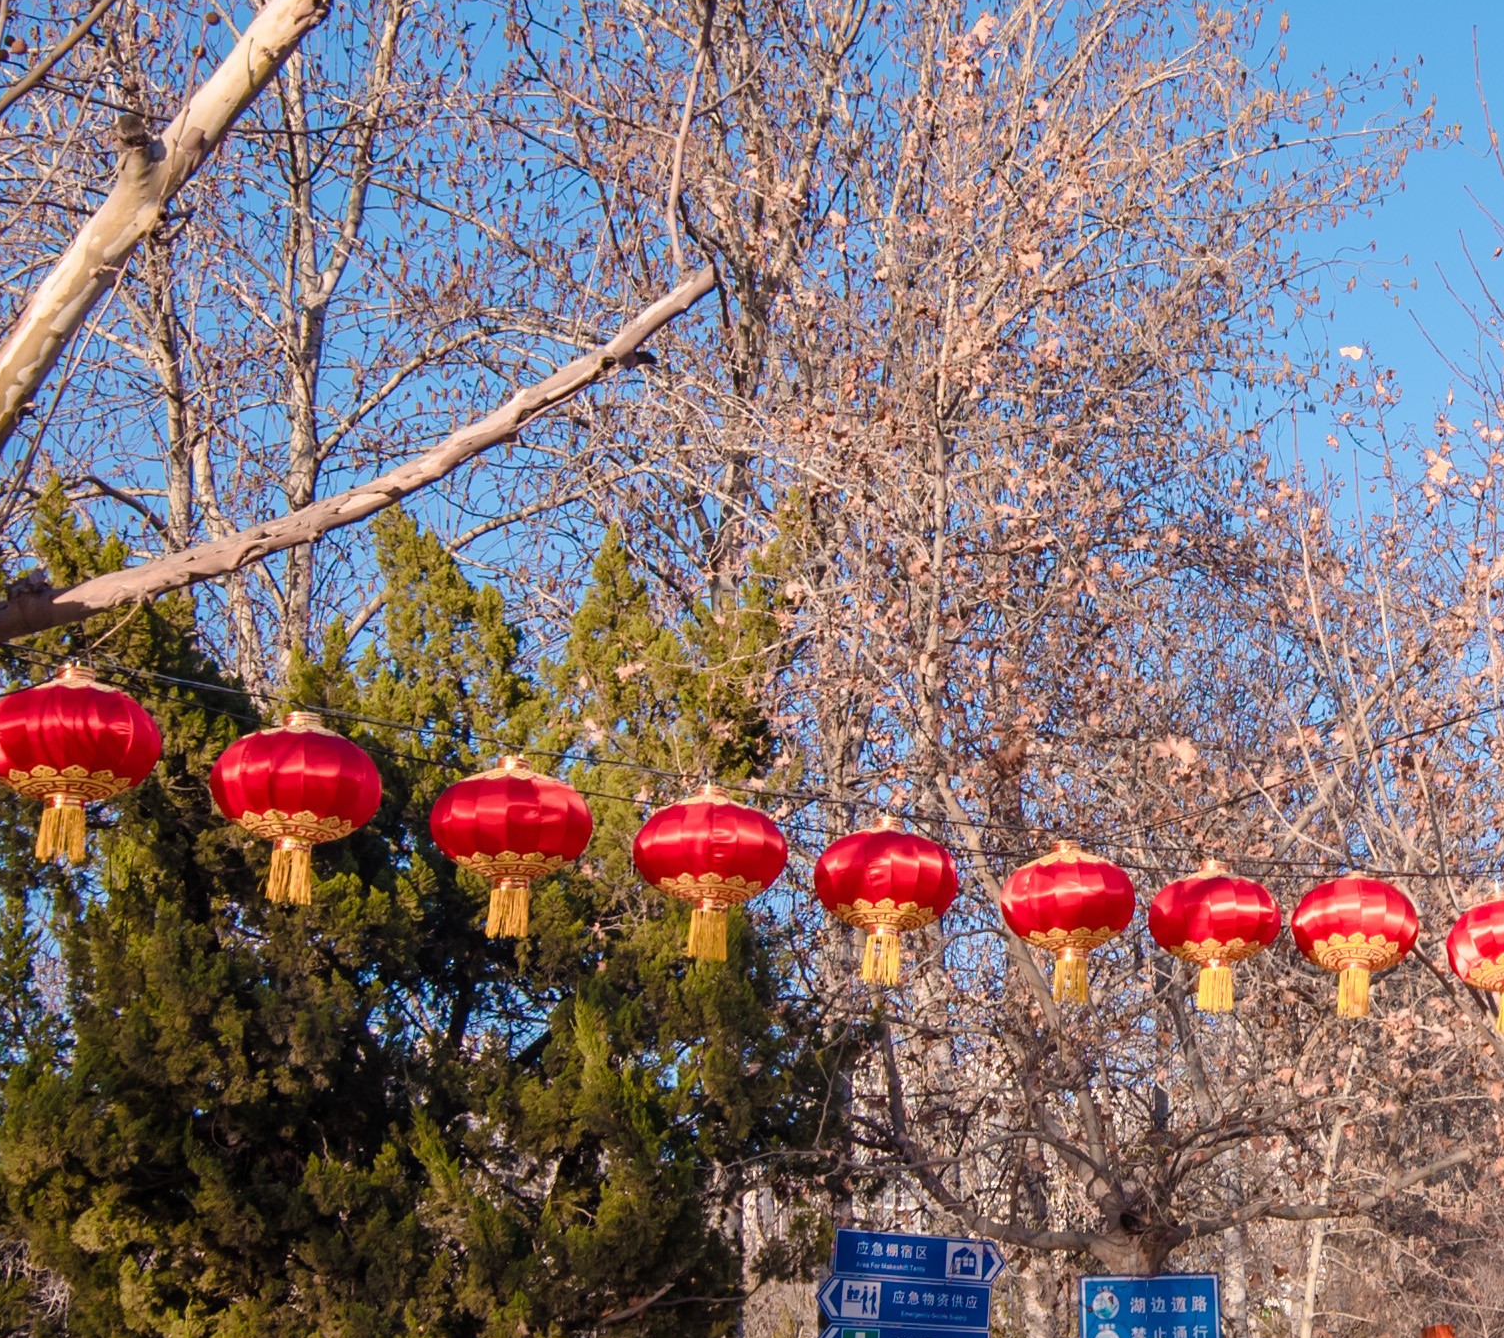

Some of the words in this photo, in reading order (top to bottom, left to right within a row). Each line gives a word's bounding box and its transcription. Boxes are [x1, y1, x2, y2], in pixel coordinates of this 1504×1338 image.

[856, 1240, 928, 1260] 应急棚宿区
[892, 1289, 978, 1309] 应急物资供应
[1130, 1295, 1207, 1314] 湖边道路
